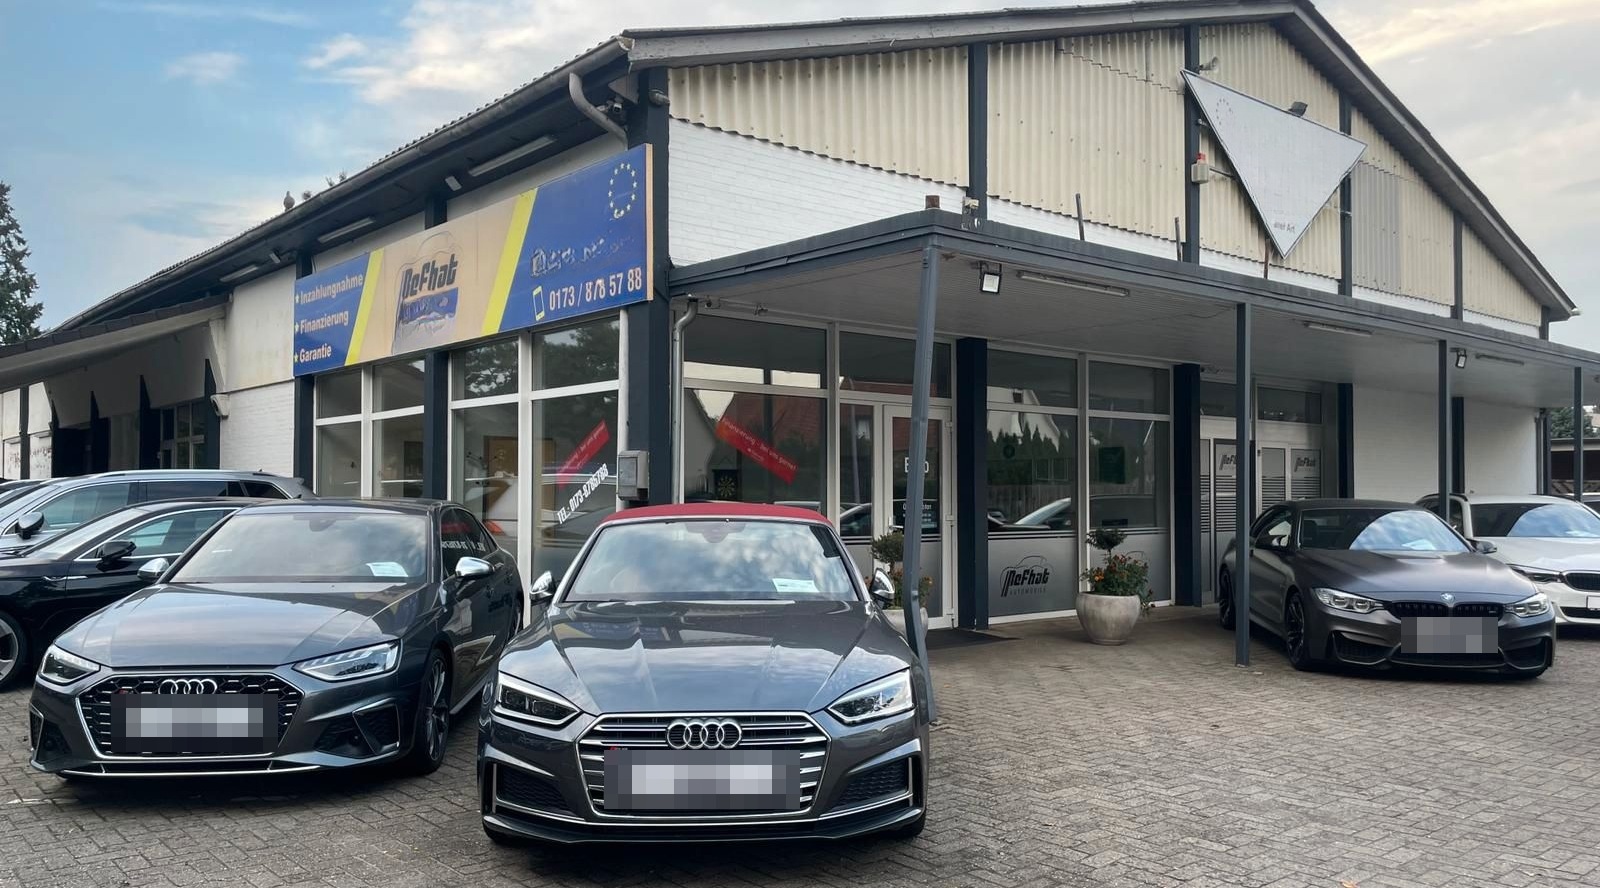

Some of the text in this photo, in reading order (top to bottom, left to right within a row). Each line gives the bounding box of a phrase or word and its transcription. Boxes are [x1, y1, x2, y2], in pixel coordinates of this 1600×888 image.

[300, 273, 363, 305] Inzahlungnahme
[550, 286, 575, 311] 0173
[585, 279, 606, 302] 878
[610, 268, 624, 297] 57
[627, 267, 642, 291] 88
[300, 310, 349, 334] Finanzierung
[300, 343, 332, 363] Garantie
